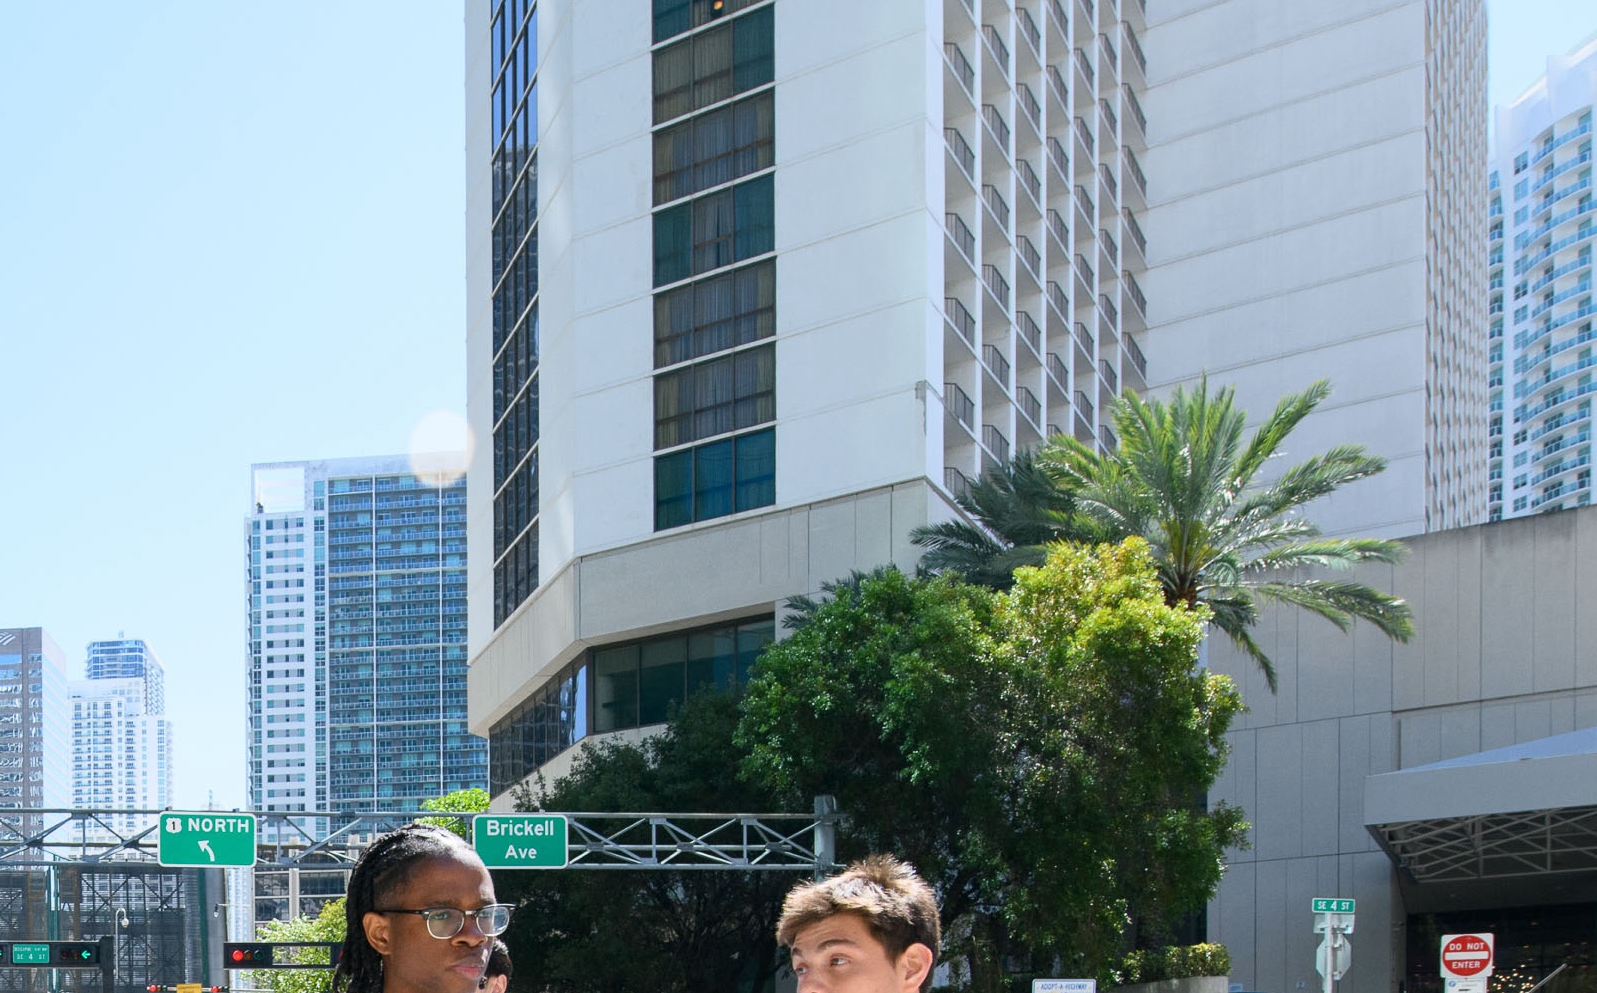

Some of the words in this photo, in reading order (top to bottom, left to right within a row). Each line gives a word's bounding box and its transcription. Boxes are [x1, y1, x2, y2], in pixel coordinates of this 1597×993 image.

[187, 817, 250, 833] NORTH
[486, 819, 554, 836] Brickell
[504, 844, 537, 859] Ave
[1317, 901, 1327, 910] SE
[1330, 900, 1337, 911] 4
[1341, 901, 1350, 911] ST
[1449, 943, 1462, 951] DO
[1466, 942, 1484, 951] NOT
[28, 953, 34, 961] 4
[1452, 961, 1481, 969] ENTER
